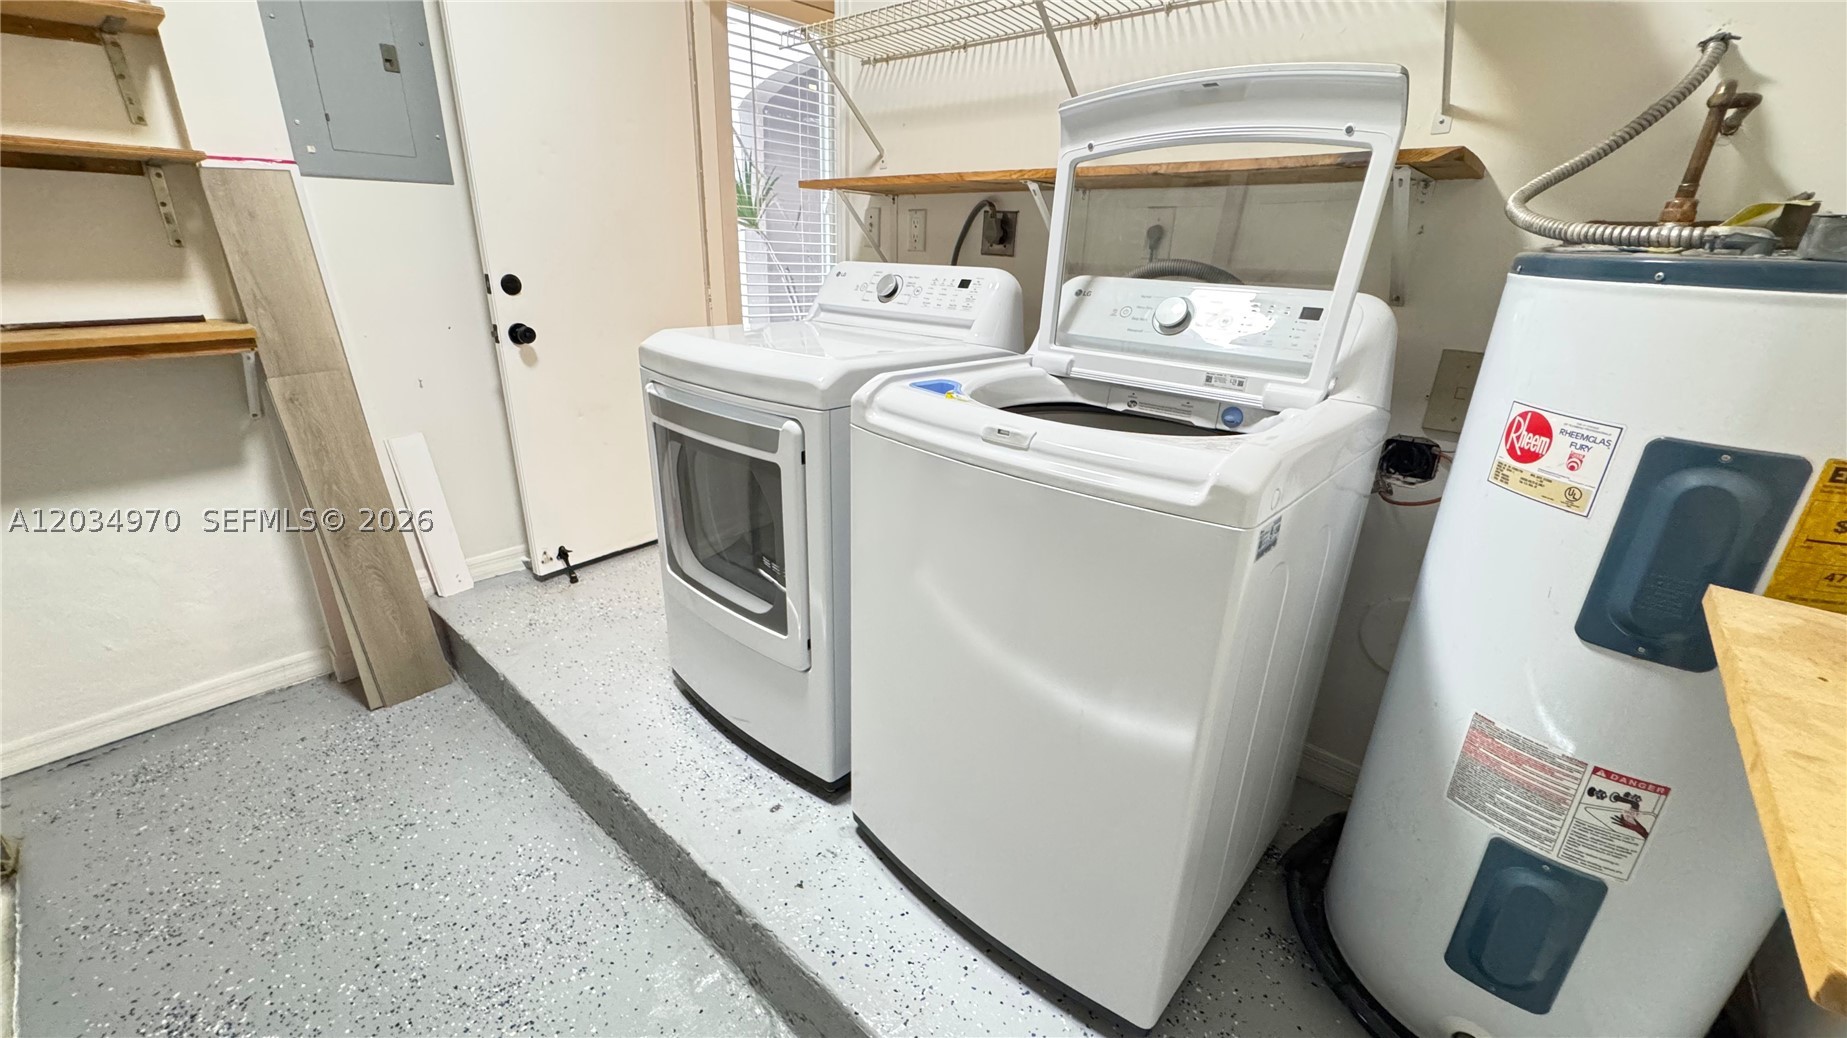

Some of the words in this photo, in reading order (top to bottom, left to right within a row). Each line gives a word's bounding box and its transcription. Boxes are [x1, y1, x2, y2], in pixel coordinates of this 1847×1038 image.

[1506, 412, 1551, 456] Rheem
[1569, 441, 1593, 453] FURY
[1609, 774, 1666, 794] DANGER
